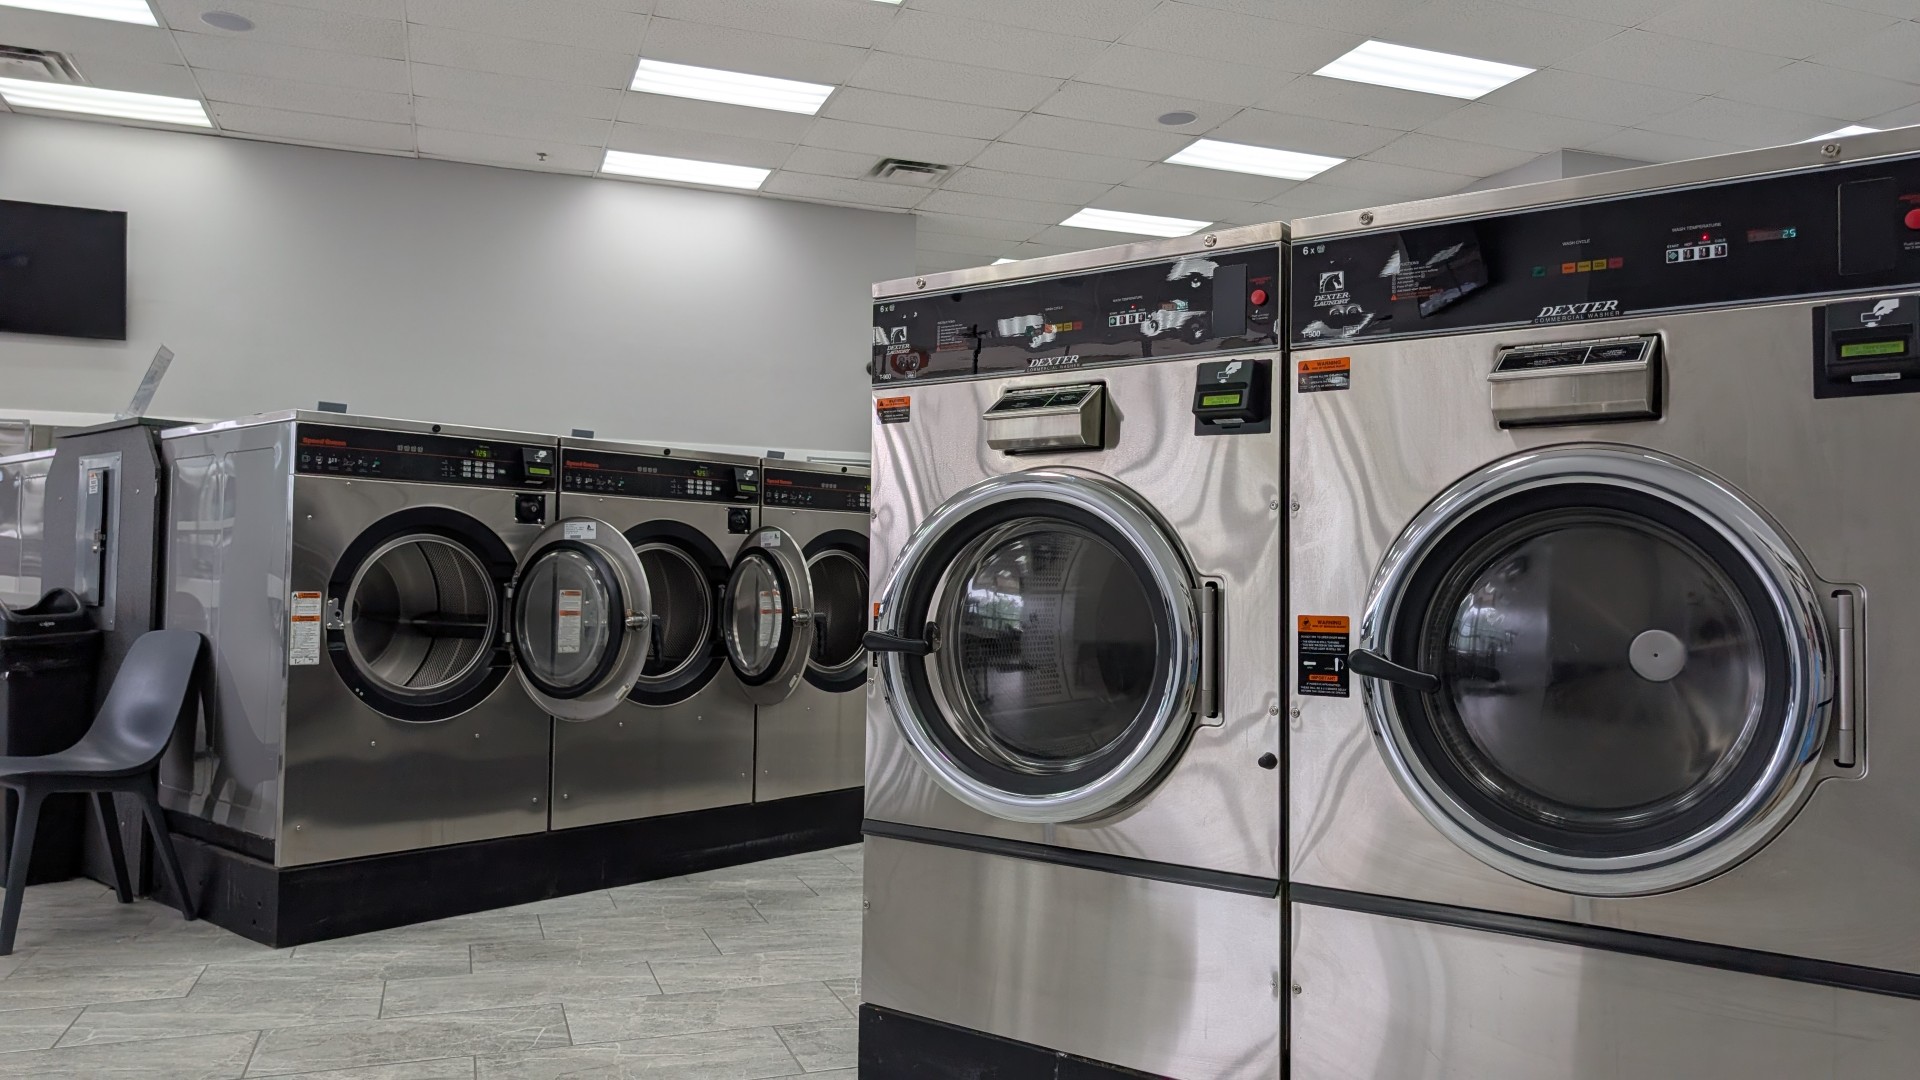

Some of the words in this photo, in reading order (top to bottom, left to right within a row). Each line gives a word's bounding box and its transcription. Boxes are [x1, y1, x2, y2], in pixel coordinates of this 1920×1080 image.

[1782, 228, 1796, 239] 25
[1302, 246, 1310, 256] 6
[1313, 291, 1350, 302] DEXTER
[1312, 298, 1351, 308] LAUNDRY
[1537, 299, 1619, 318] DEXTER
[1534, 313, 1585, 324] COMMERCIAL
[1587, 310, 1620, 319] WASHER
[886, 343, 911, 351] DEXTER
[1028, 354, 1080, 368] DEXTER
